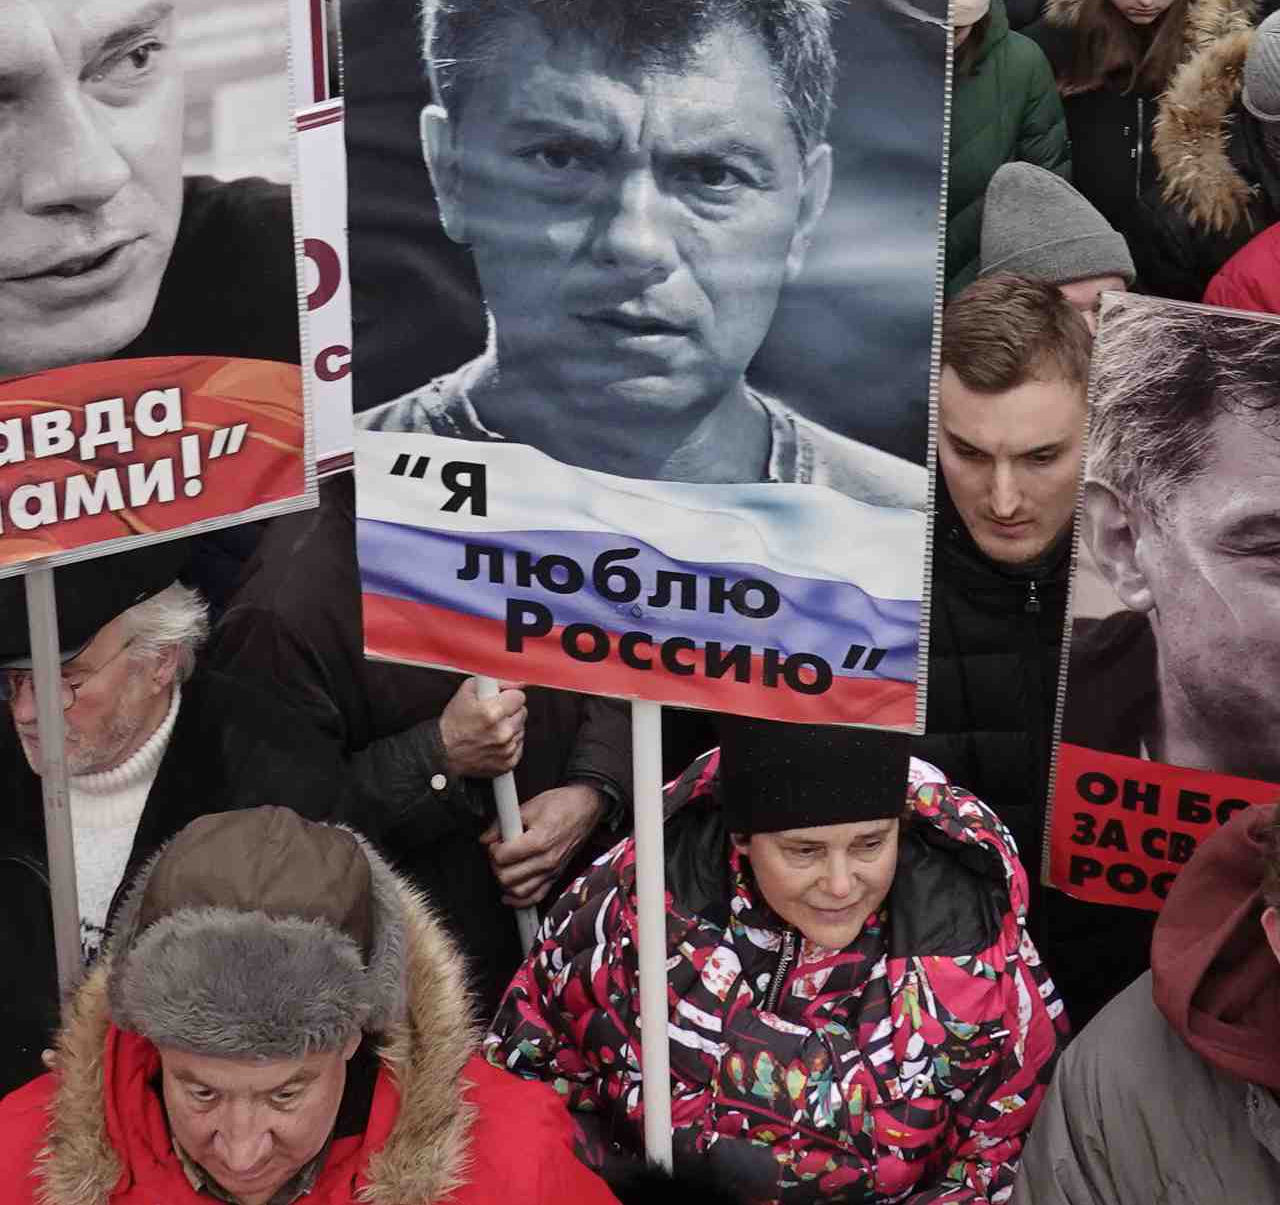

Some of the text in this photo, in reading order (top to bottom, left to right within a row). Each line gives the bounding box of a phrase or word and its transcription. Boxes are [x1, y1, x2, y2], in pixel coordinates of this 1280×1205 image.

[389, 452, 489, 518] “Я
[456, 542, 783, 622] люблю
[503, 598, 890, 697] Россию”
[1076, 771, 1161, 817] ОН
[1070, 811, 1130, 853] ЗА
